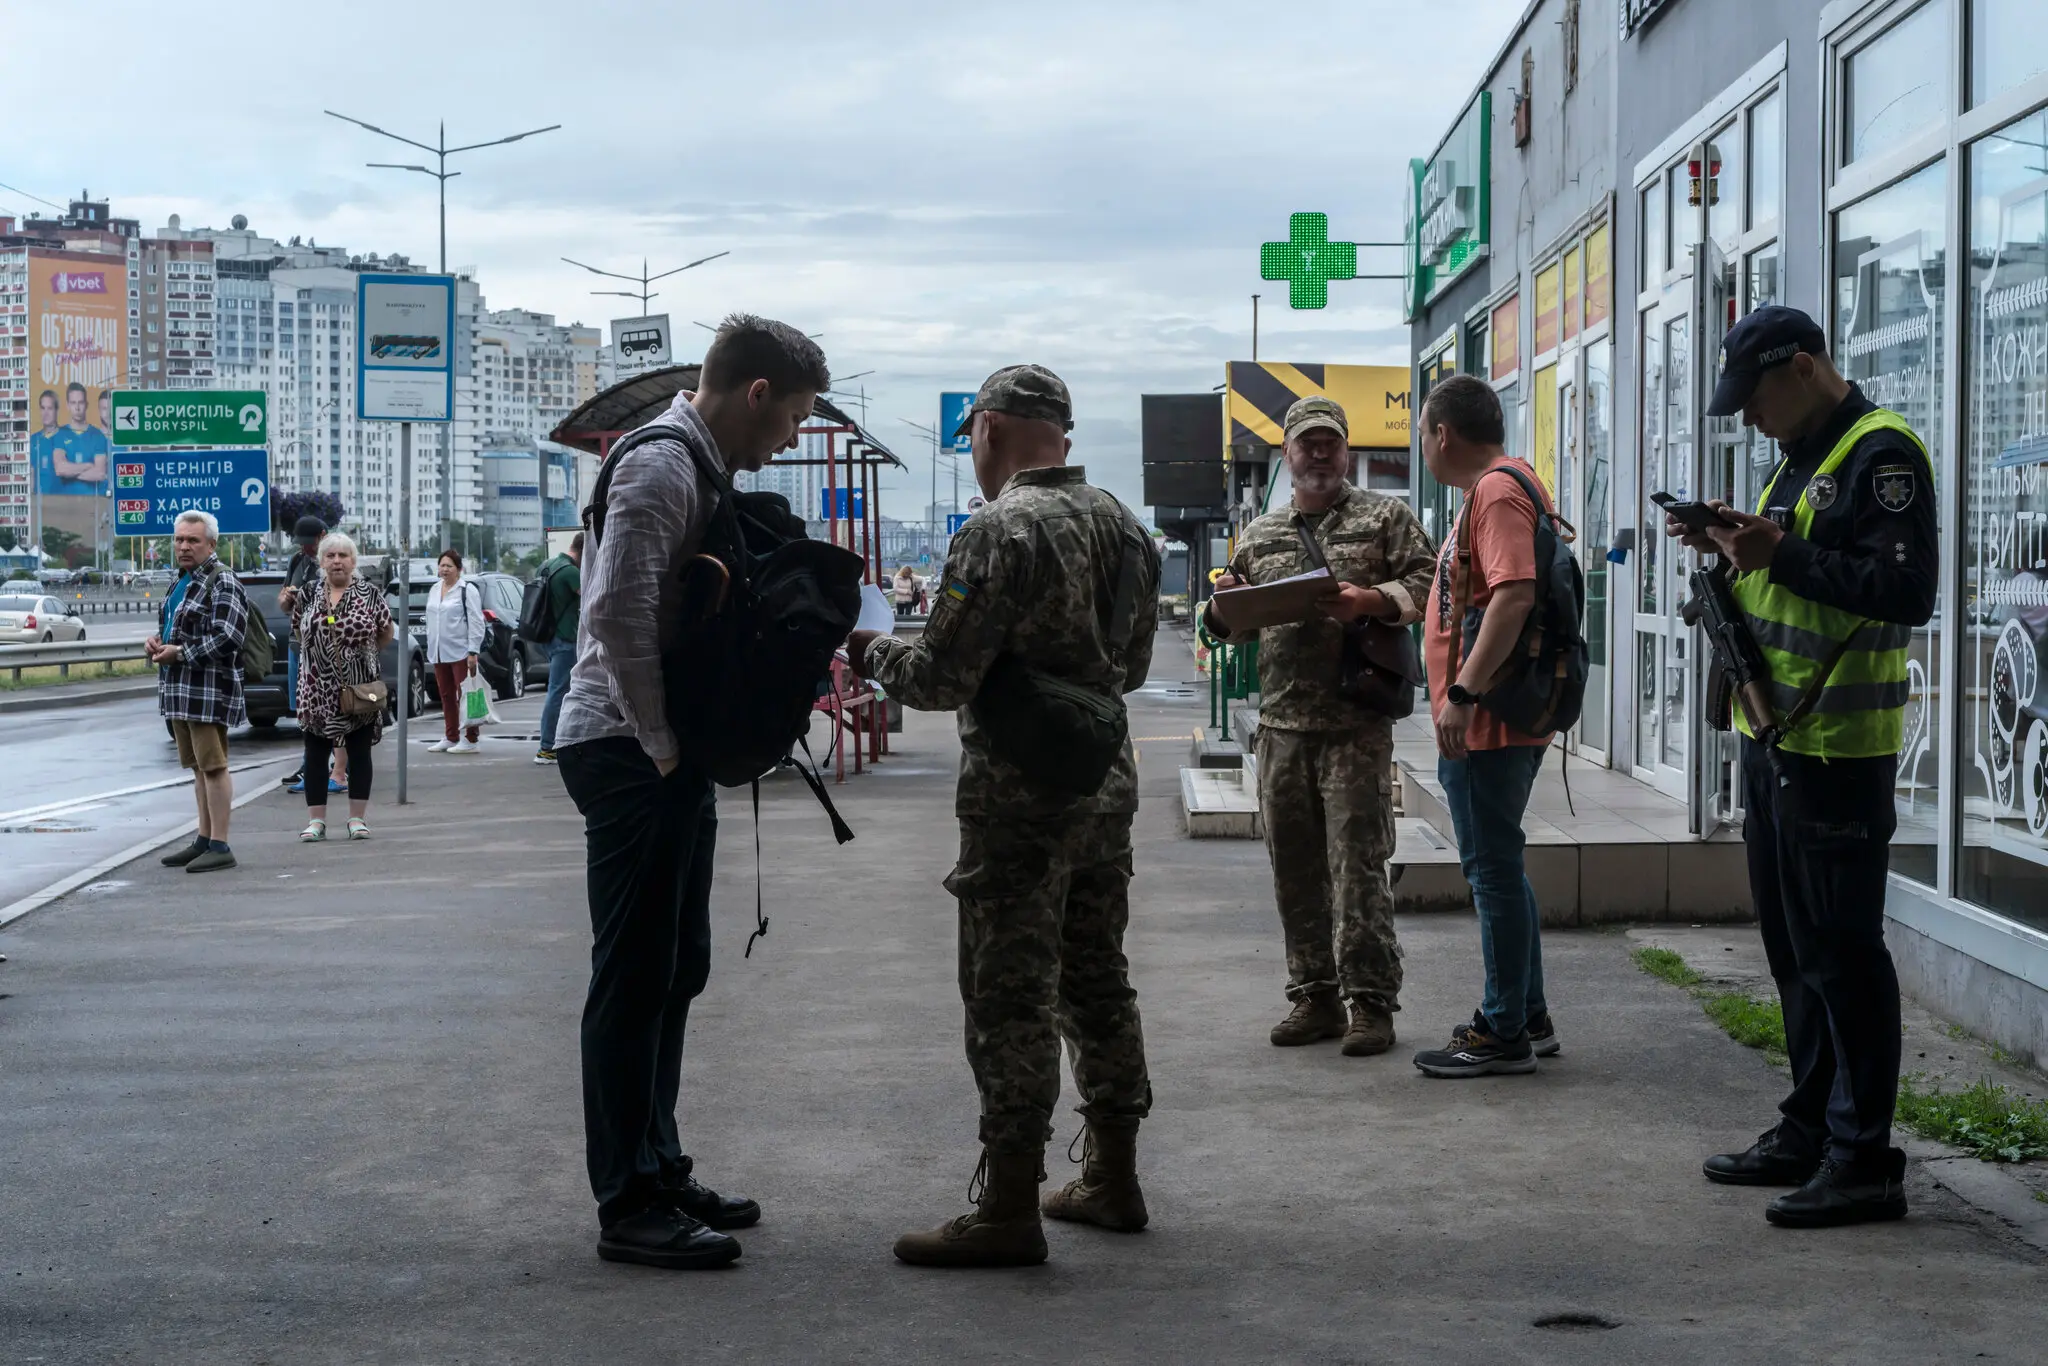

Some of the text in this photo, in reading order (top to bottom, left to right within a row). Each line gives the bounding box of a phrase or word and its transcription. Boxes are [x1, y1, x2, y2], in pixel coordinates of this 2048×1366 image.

[69, 277, 102, 289] vbet
[144, 404, 234, 418] БОРИСПІЛЬ
[144, 420, 208, 431] BORYSPIL
[2020, 390, 2048, 449] ДН
[155, 461, 234, 475] ЧЕРНІГІВ
[155, 477, 220, 488] CHERNIHIV
[156, 497, 222, 511] ХАРКІВ
